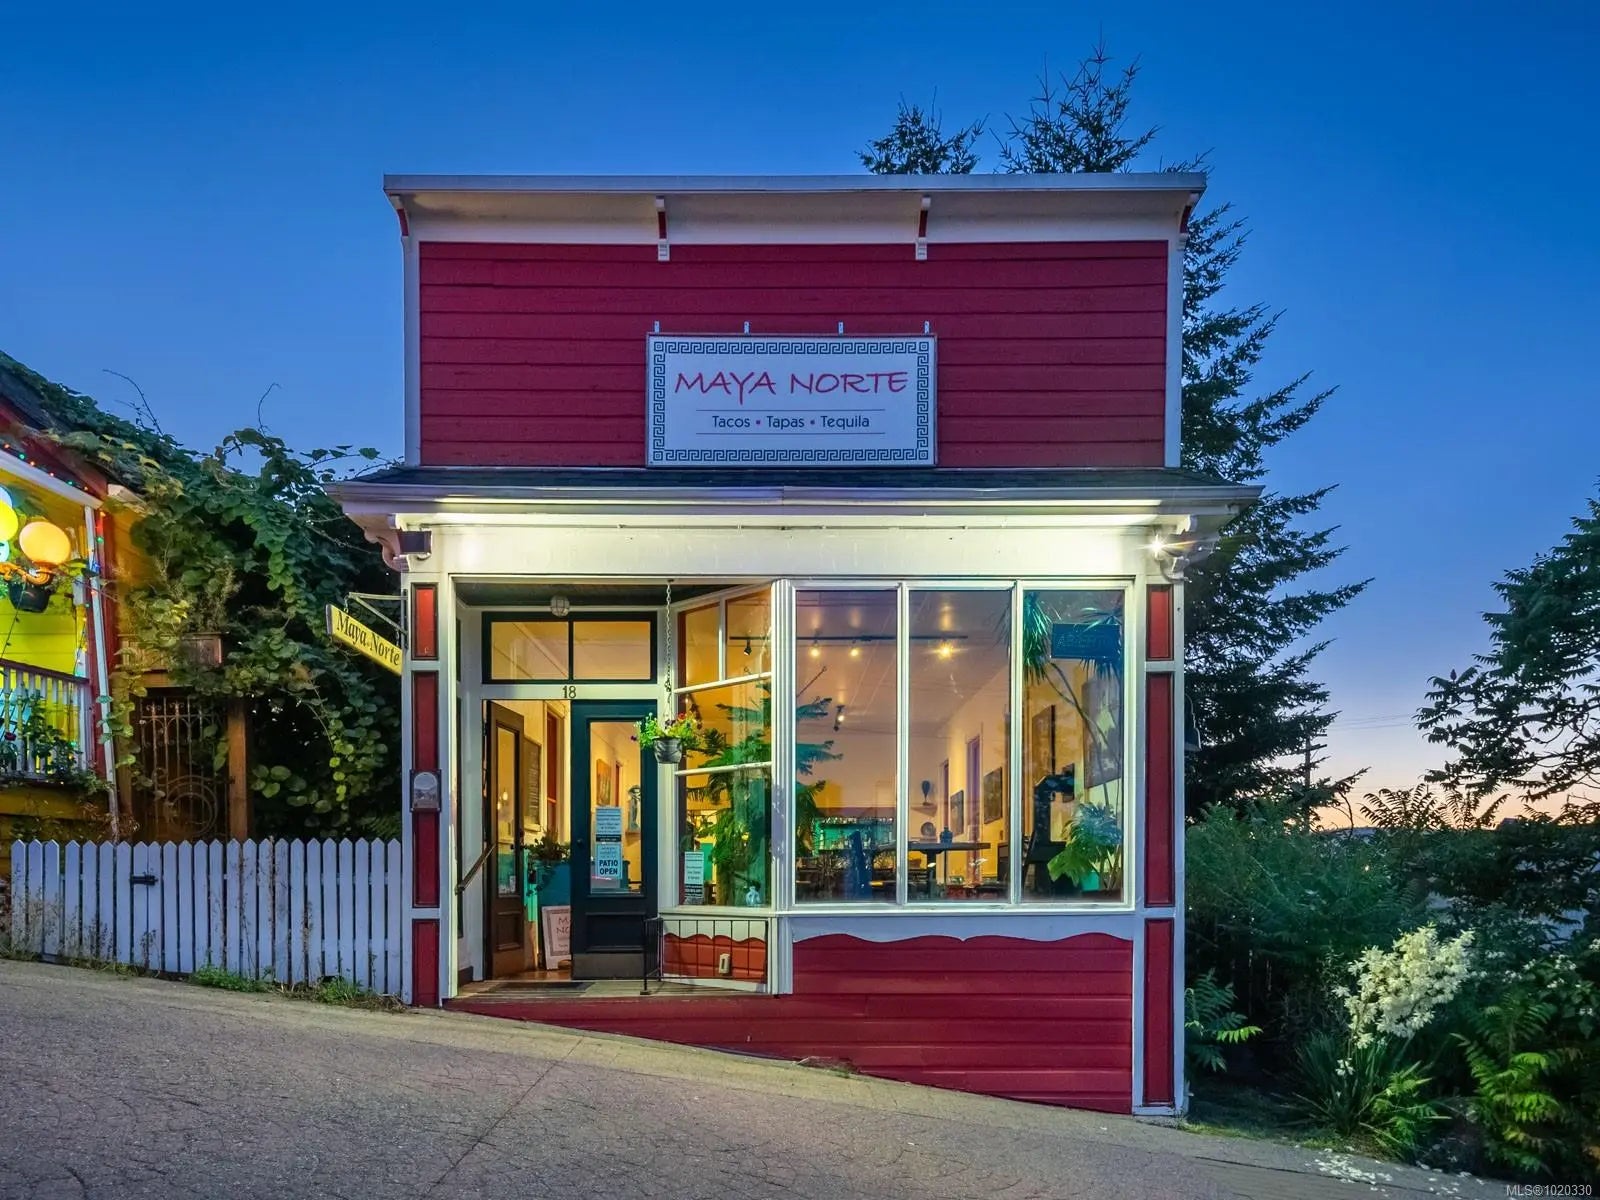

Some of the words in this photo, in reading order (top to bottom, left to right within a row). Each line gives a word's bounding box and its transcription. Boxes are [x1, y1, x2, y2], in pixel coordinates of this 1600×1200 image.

[675, 371, 777, 405] MAYA
[790, 371, 908, 395] NORTE
[712, 415, 750, 428] Tacos
[767, 415, 805, 430] Tapas
[820, 415, 870, 430] Tequila
[336, 610, 367, 646] Maya
[369, 632, 400, 666] Norte
[562, 685, 577, 699] 18
[598, 859, 619, 867] PATIO
[599, 867, 618, 875] OPEN
